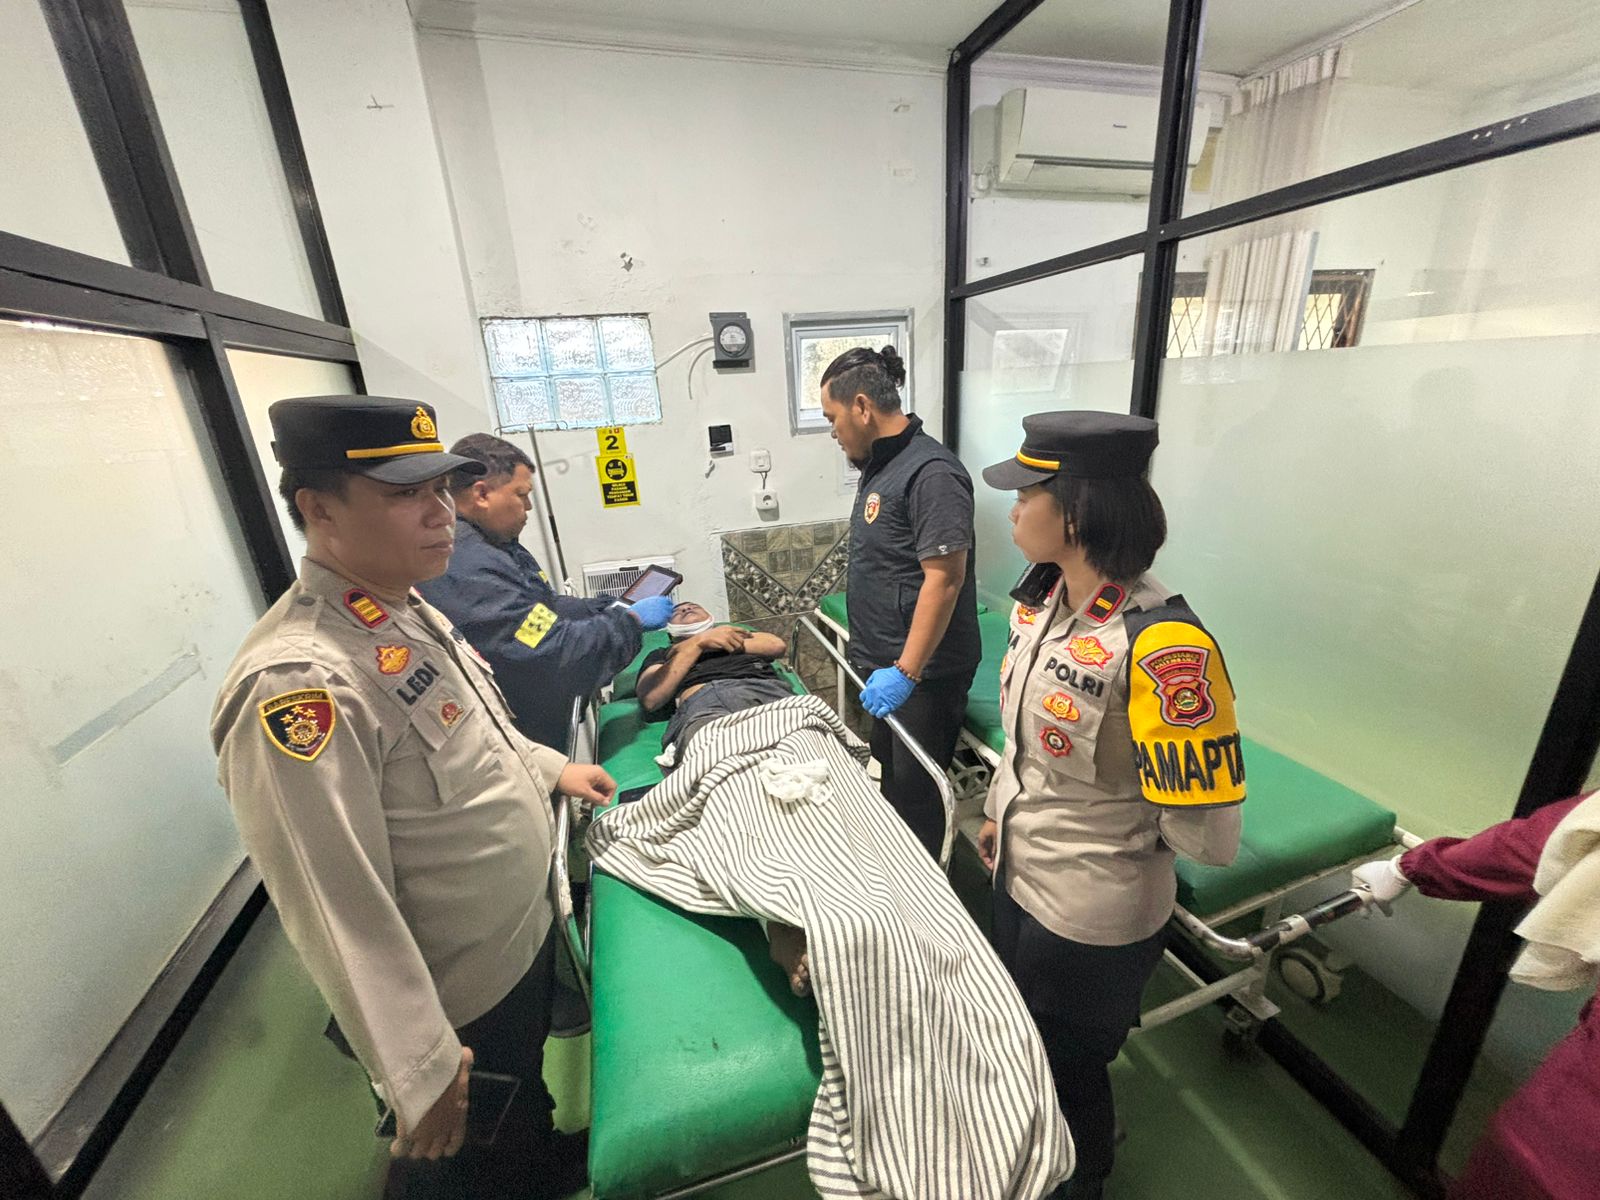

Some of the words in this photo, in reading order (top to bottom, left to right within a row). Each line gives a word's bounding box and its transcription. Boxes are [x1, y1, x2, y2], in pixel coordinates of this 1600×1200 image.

[605, 435, 619, 450] 2
[396, 661, 440, 706] LEDI
[1043, 656, 1104, 698] POLRI
